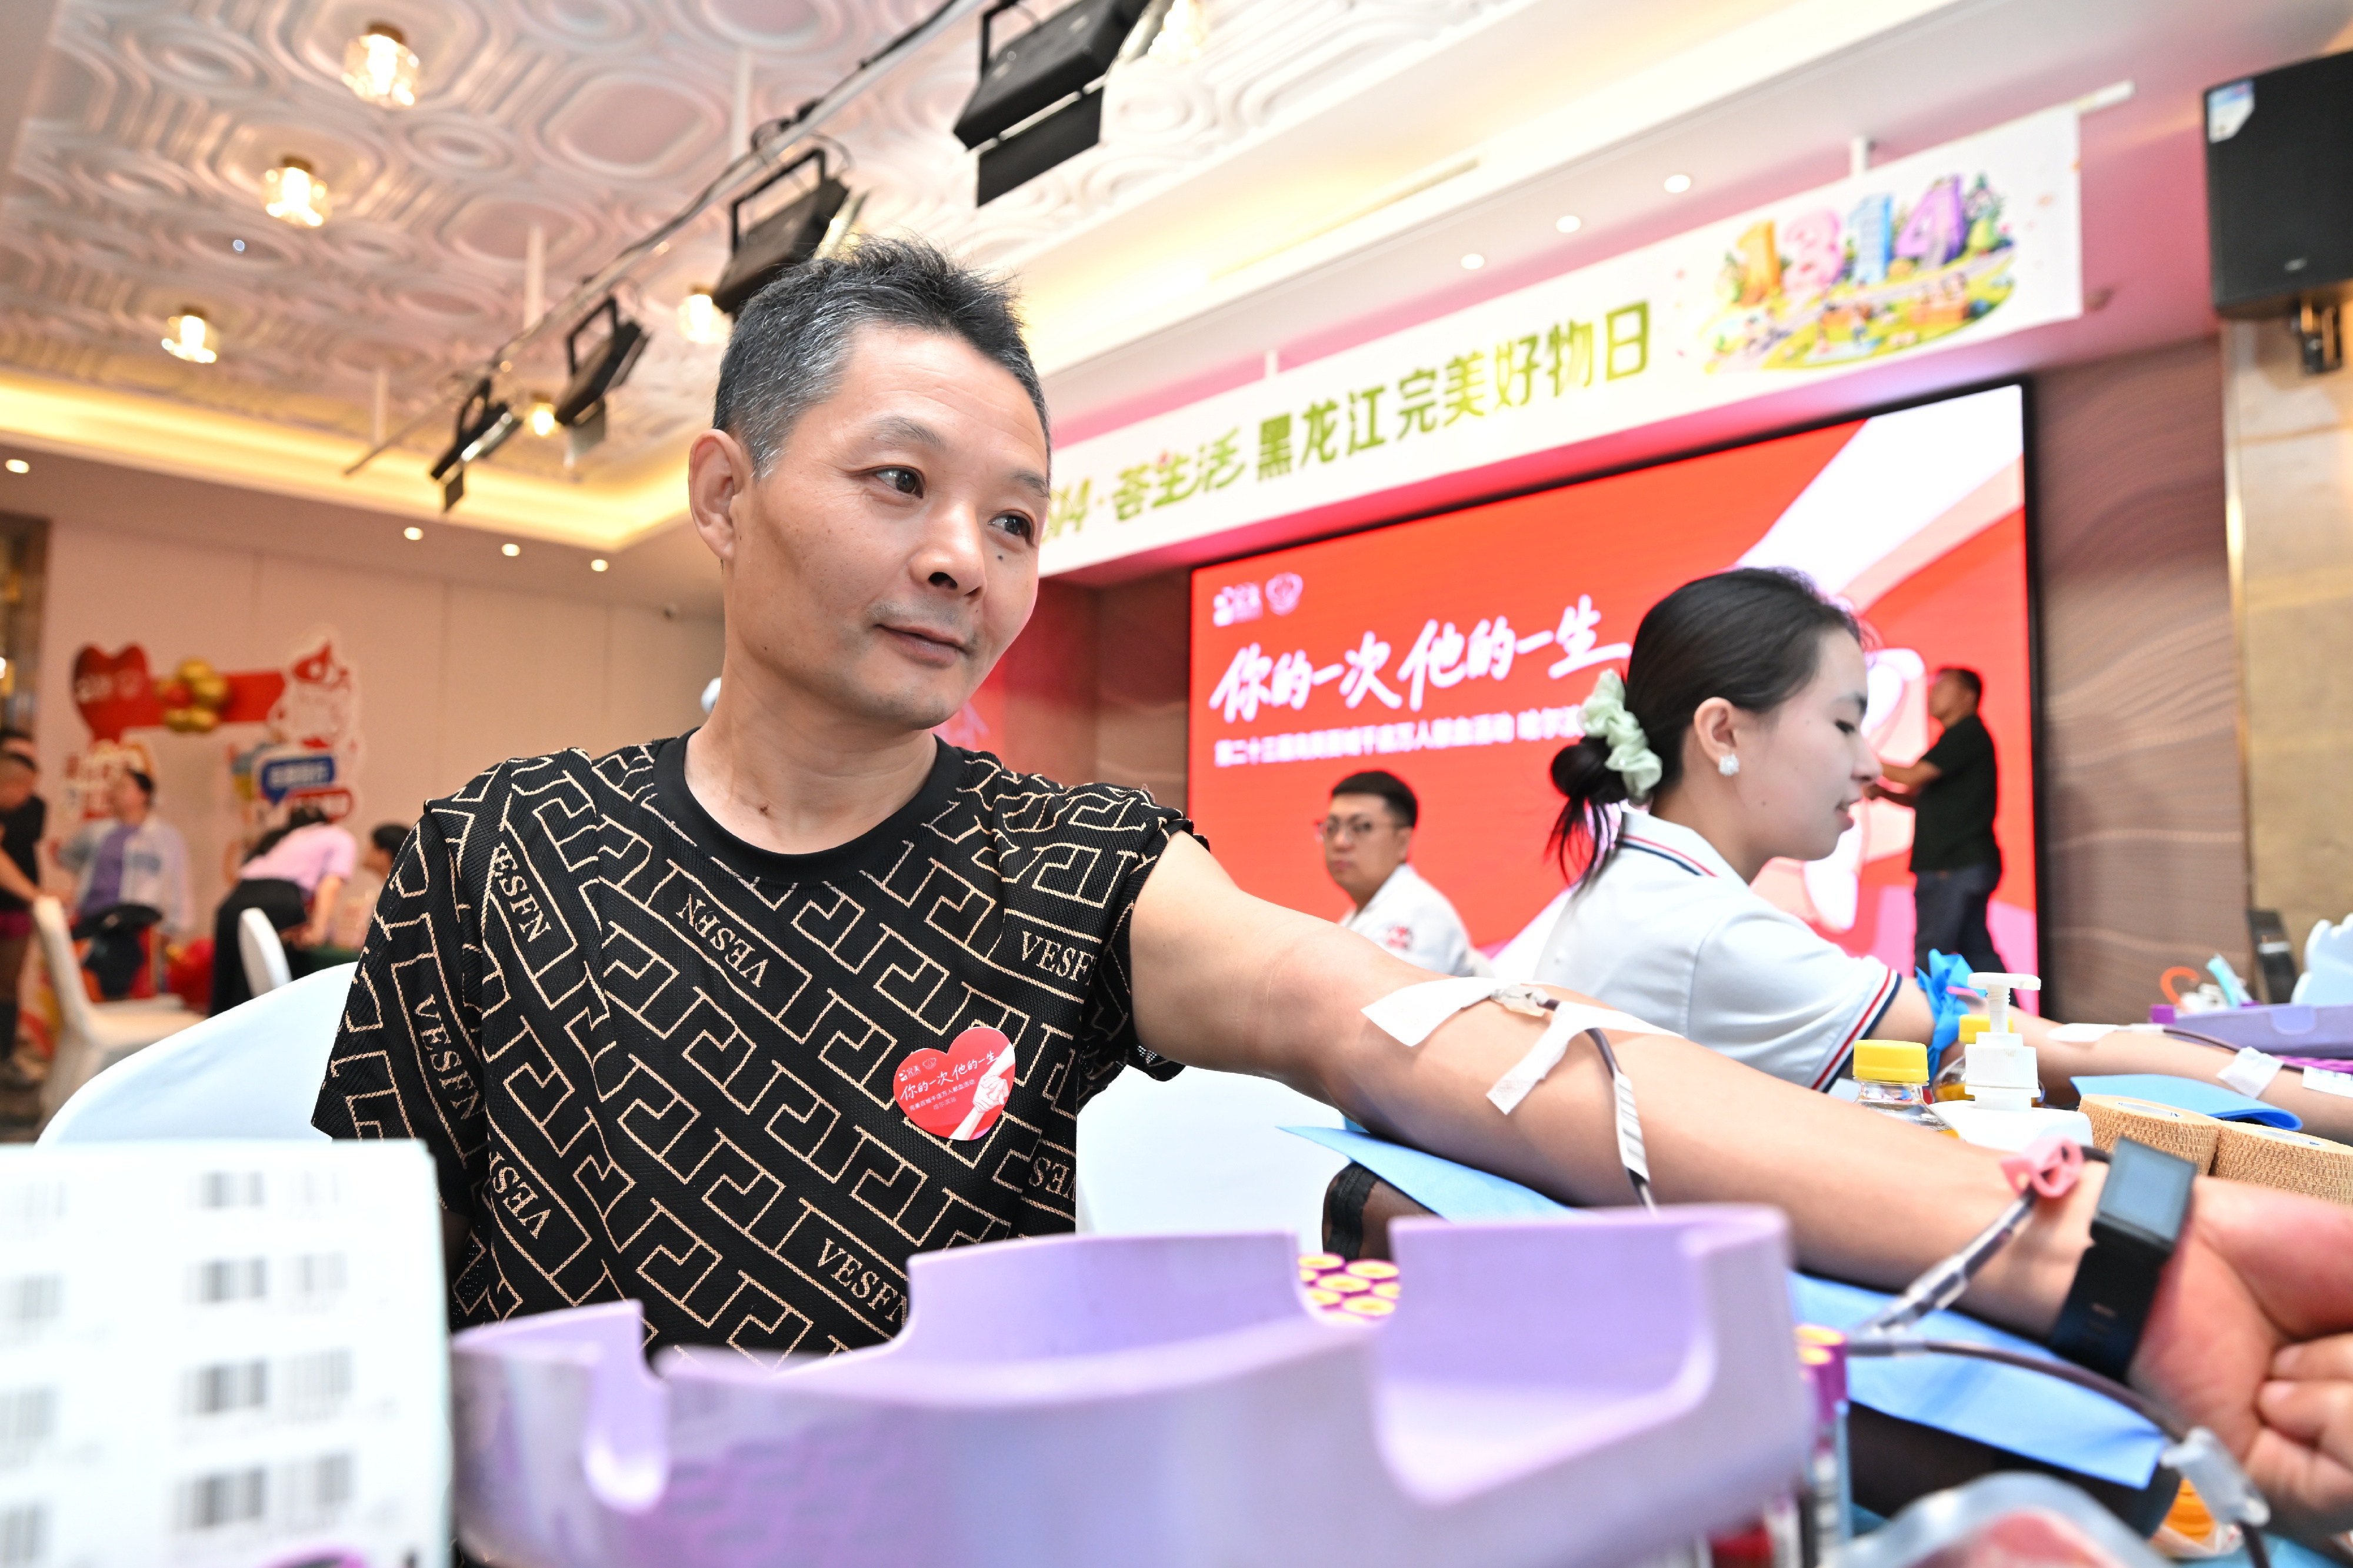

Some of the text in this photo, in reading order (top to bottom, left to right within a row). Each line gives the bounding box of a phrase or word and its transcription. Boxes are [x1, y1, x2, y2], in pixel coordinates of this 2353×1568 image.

[1737, 175, 1965, 307] 1314
[1209, 594, 1631, 723] 你的一次 他的一生
[494, 842, 552, 943] ESFN
[1022, 930, 1098, 986] VESF
[900, 1071, 954, 1101] 你的一次
[952, 1050, 999, 1080] 他的一生
